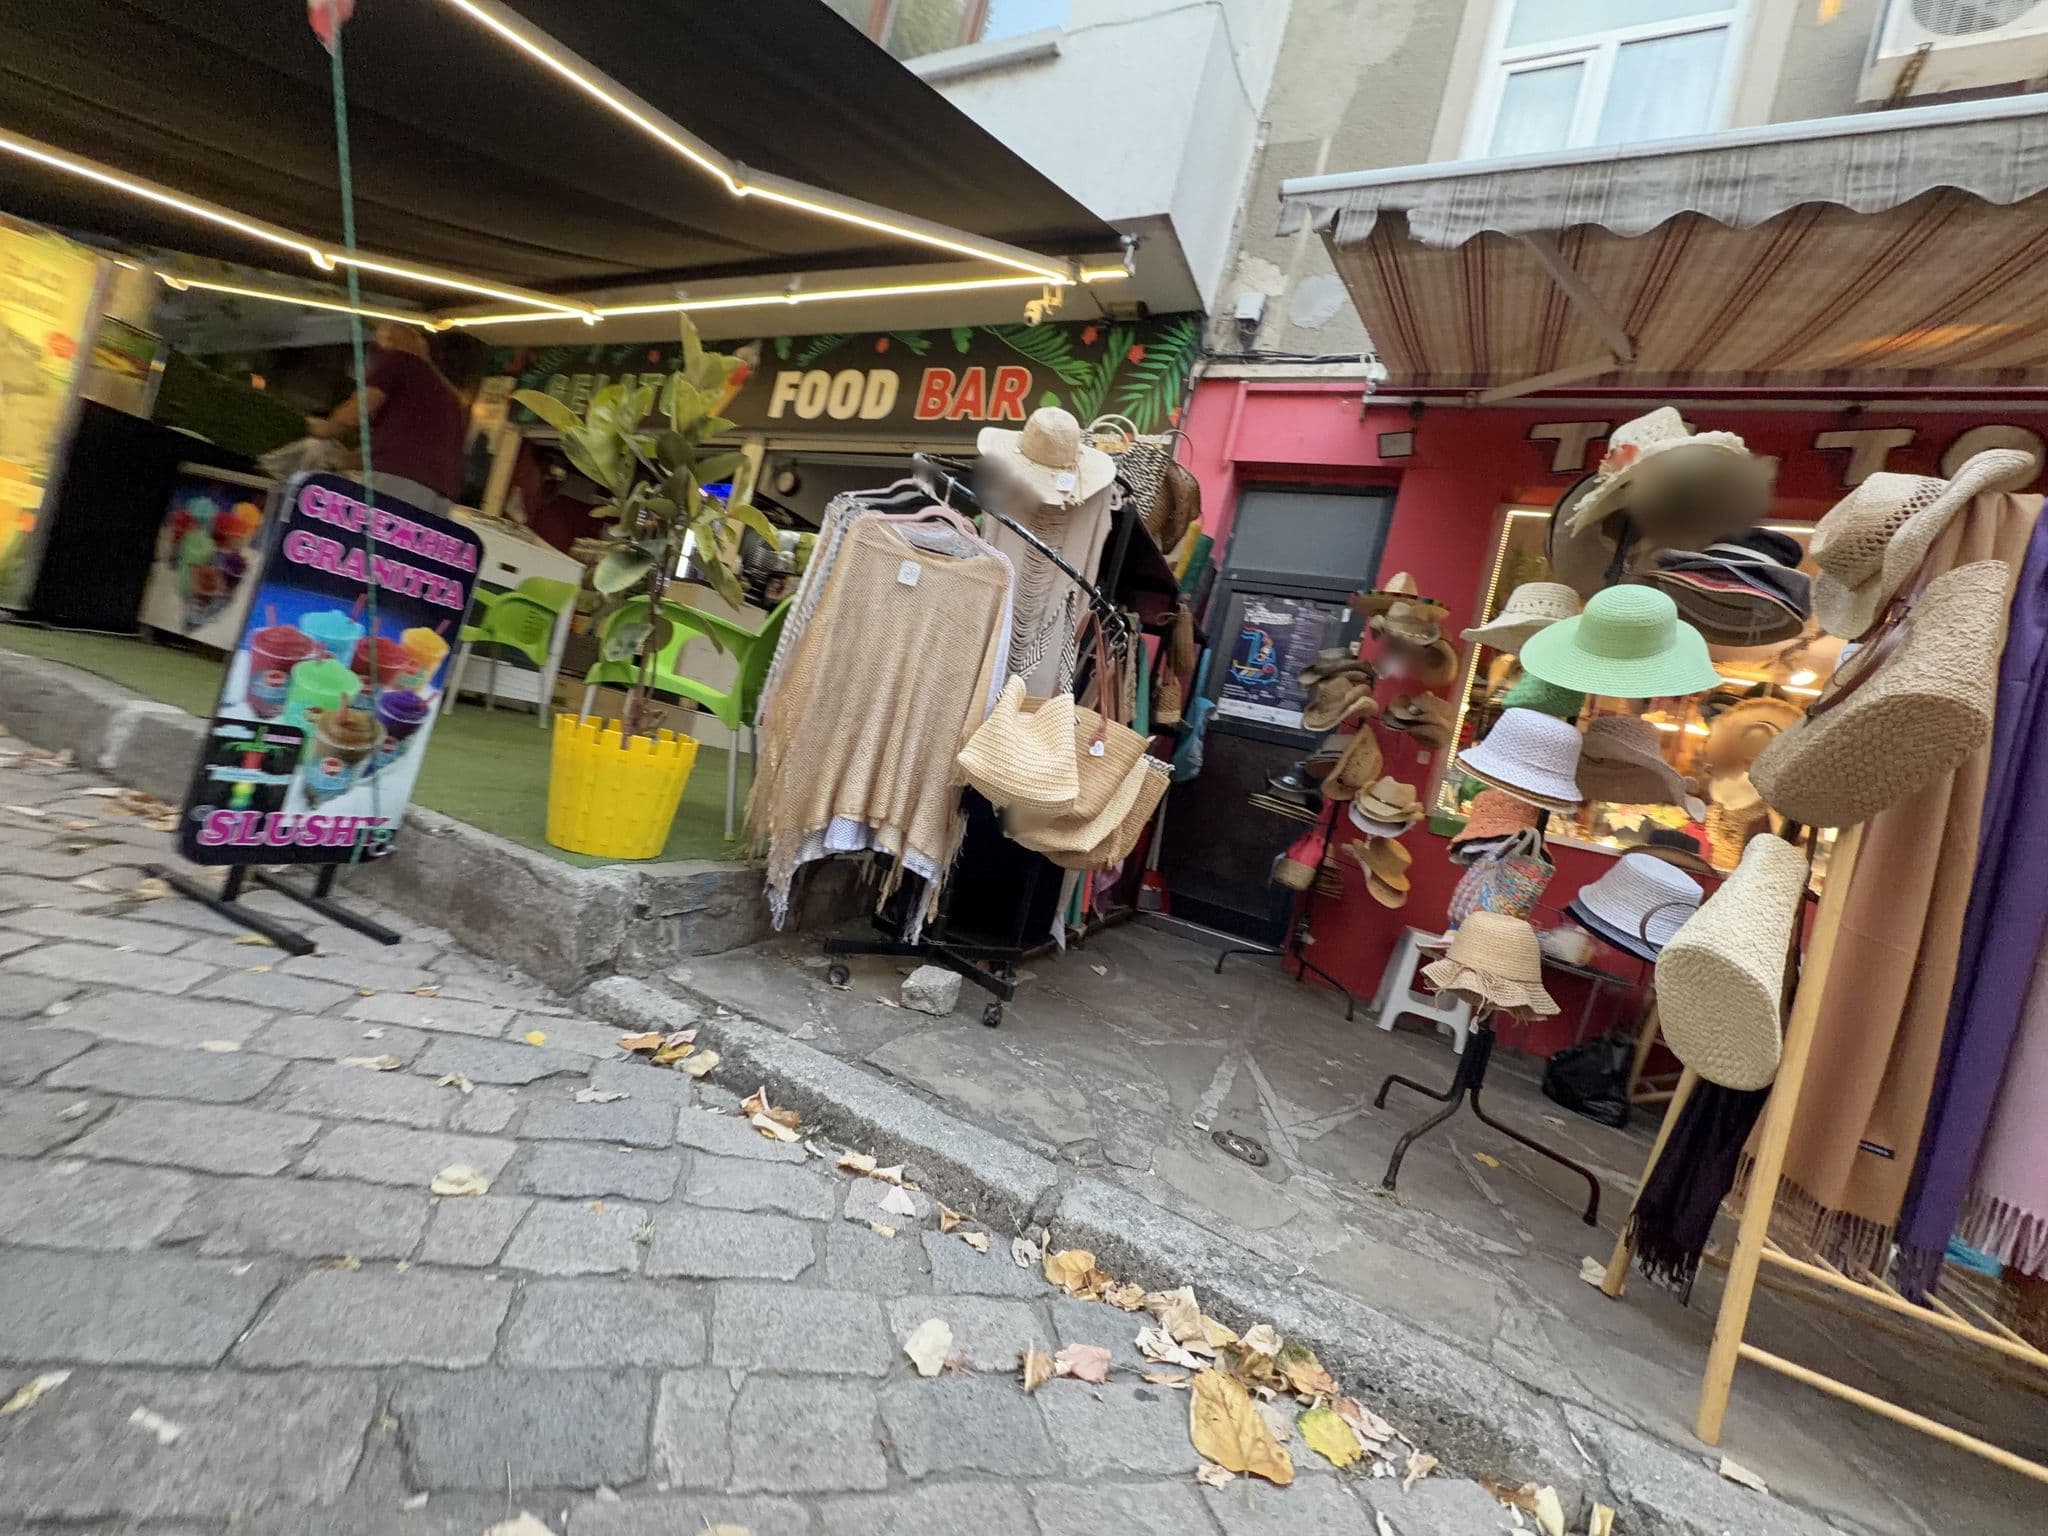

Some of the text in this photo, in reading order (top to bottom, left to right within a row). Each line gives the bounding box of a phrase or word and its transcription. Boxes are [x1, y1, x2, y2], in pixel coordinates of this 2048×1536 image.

[768, 366, 1032, 420] FOOD BAR
[283, 530, 465, 611] GRANITTA
